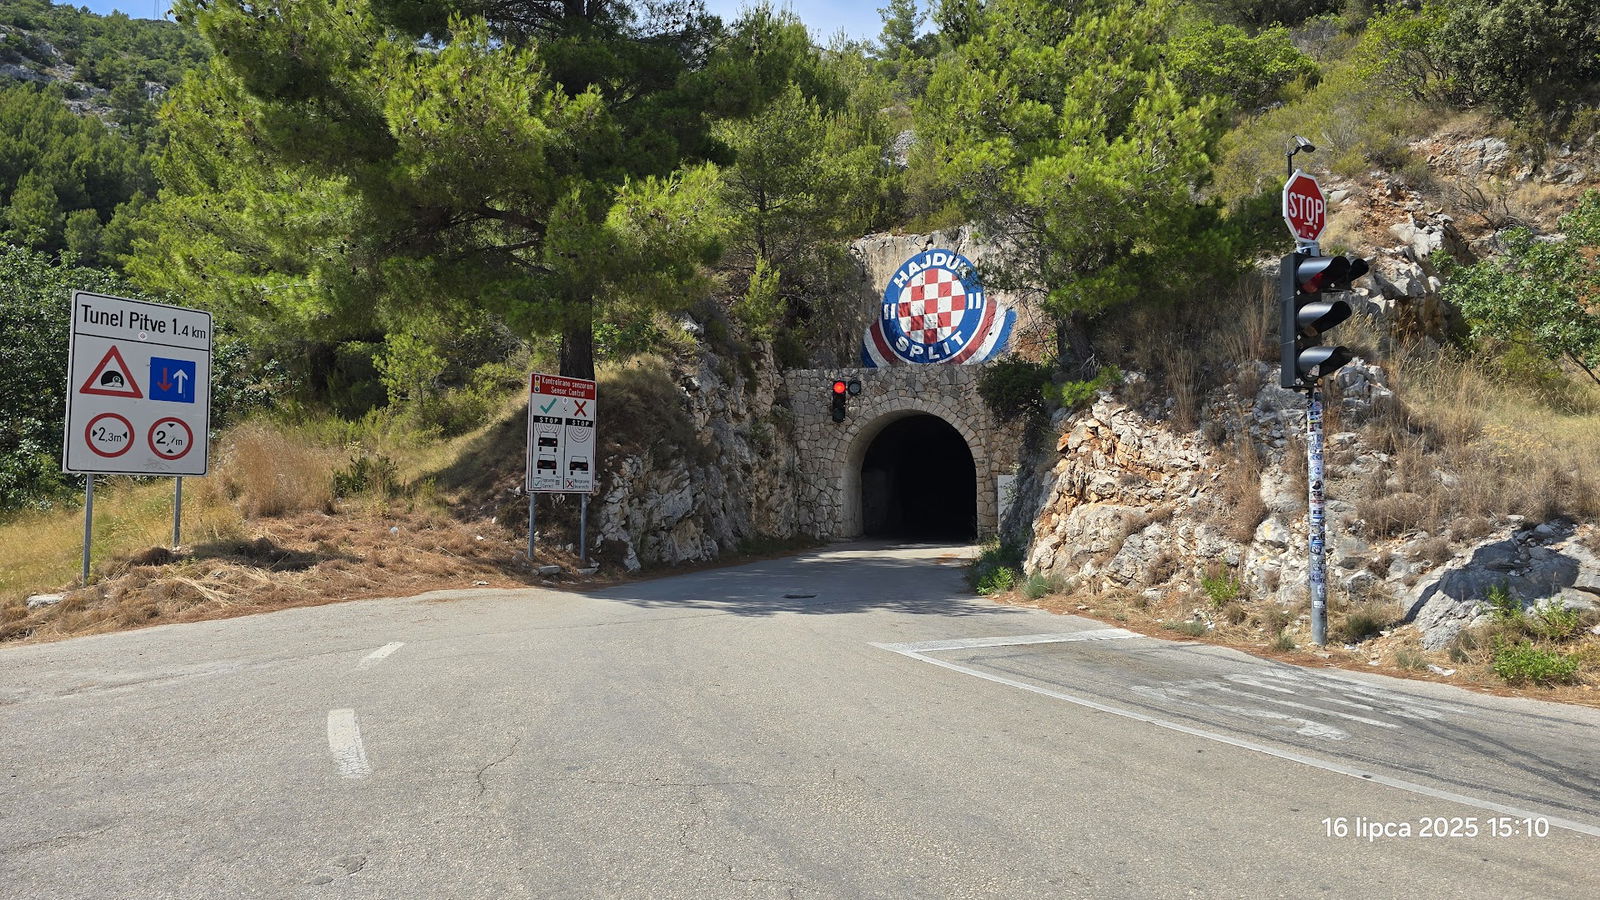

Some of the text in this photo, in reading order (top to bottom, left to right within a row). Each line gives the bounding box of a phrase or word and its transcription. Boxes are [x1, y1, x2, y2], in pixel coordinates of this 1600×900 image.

[1289, 191, 1324, 224] STOP
[893, 252, 966, 289] HAJDU
[81, 304, 206, 340] Tunel Pitve 1.4 km
[895, 329, 964, 360] SPLIT
[551, 386, 586, 397] Sensor Control
[539, 416, 559, 424] STOP
